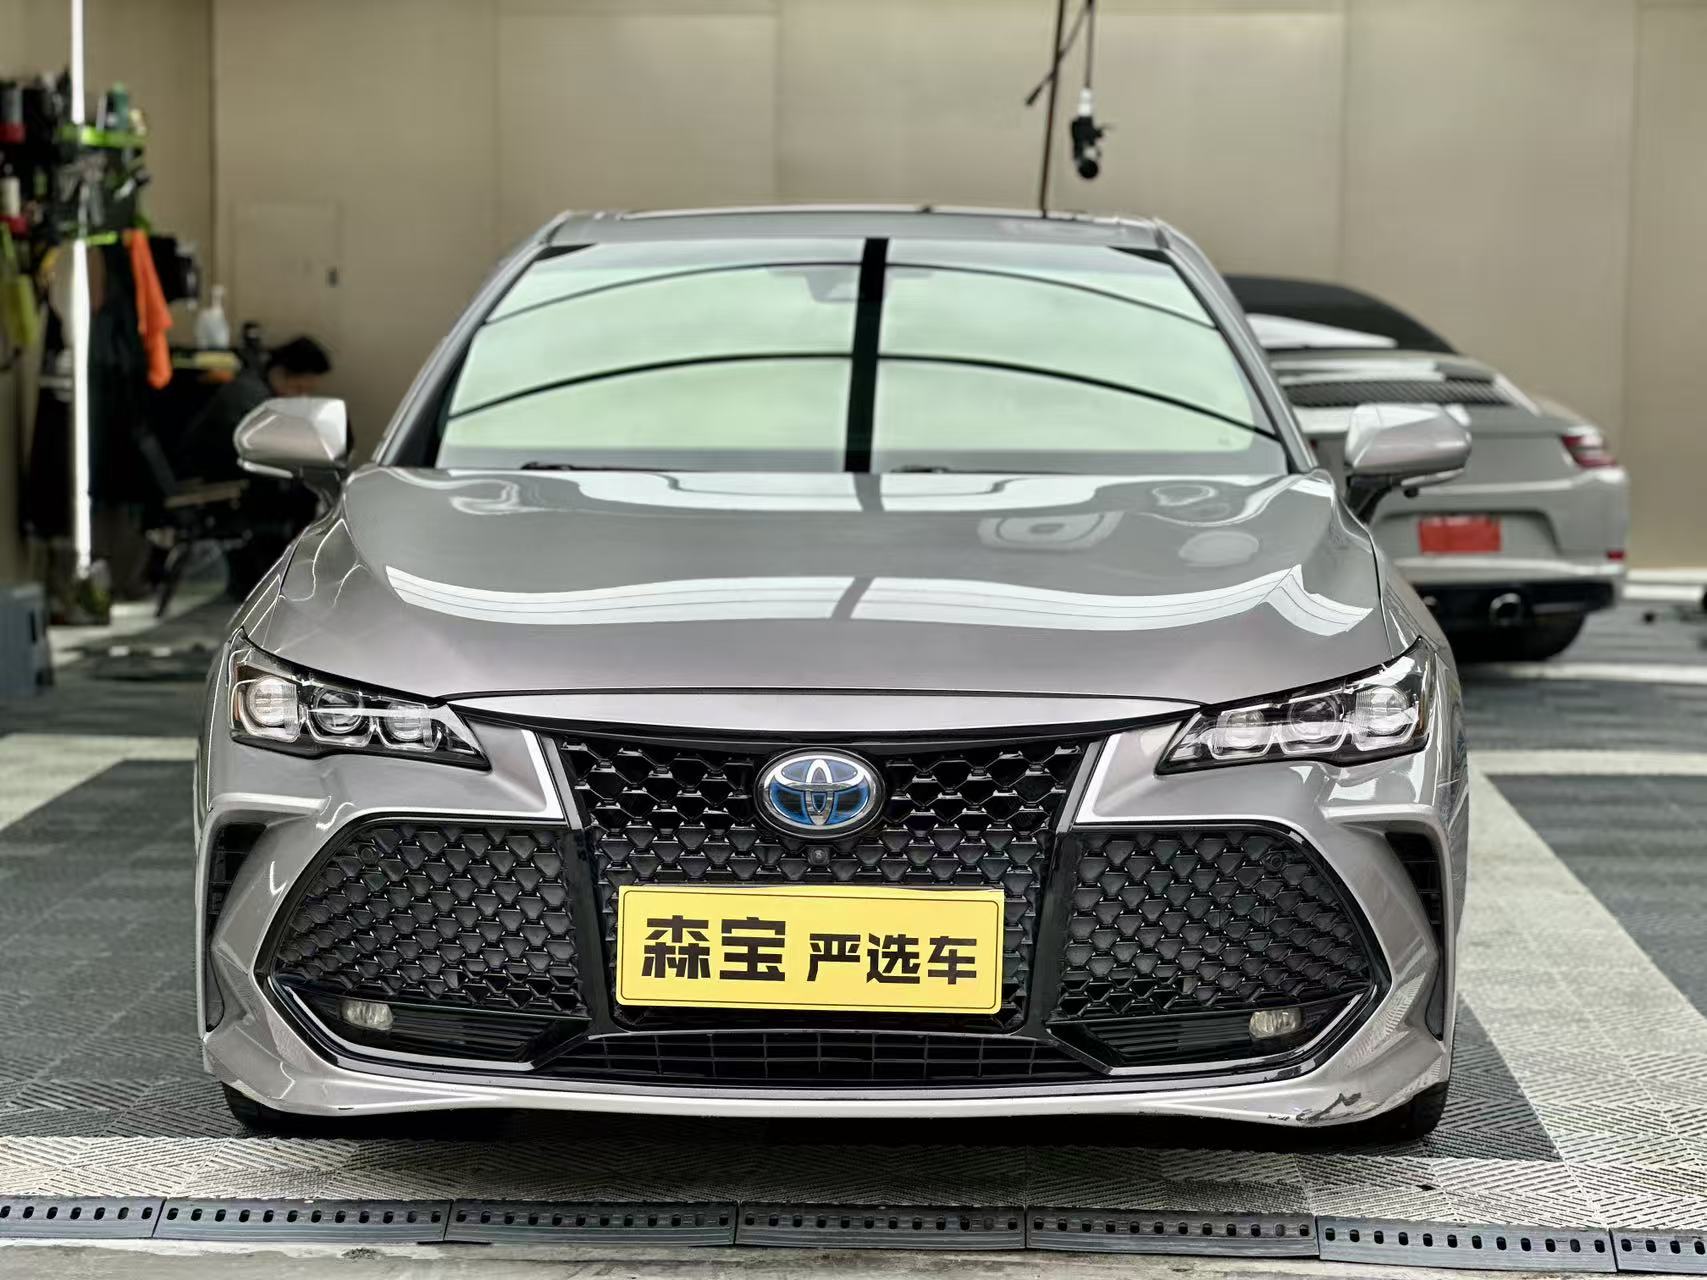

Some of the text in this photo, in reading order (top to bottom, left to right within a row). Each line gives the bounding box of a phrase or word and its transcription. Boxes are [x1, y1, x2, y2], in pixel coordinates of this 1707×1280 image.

[641, 915, 977, 985] 森宝 严选车
